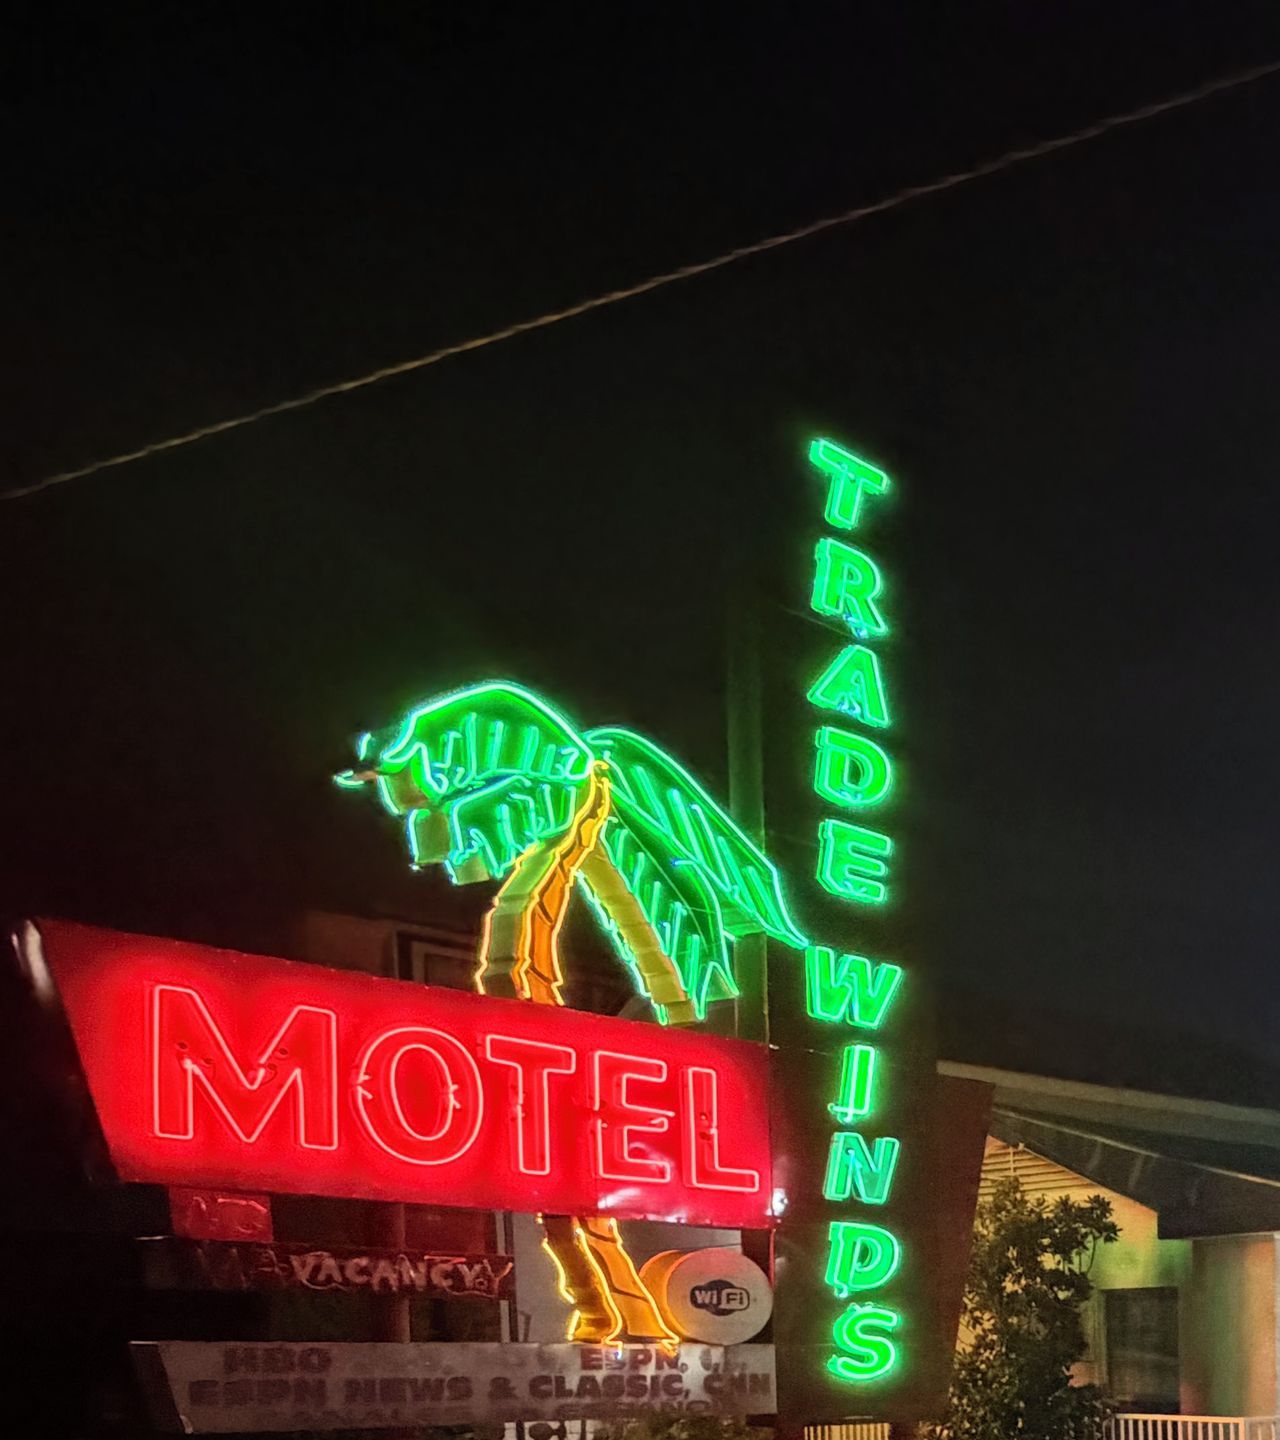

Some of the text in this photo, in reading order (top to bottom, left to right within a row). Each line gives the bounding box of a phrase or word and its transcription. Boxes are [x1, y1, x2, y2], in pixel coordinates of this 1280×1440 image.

[803, 437, 903, 1381] TRADE WINDS
[152, 983, 760, 1194] MOTEL
[224, 1346, 332, 1373] HBO
[345, 1376, 473, 1402] NEWS
[488, 1376, 516, 1400] &
[528, 1373, 691, 1399] CLASSIC,
